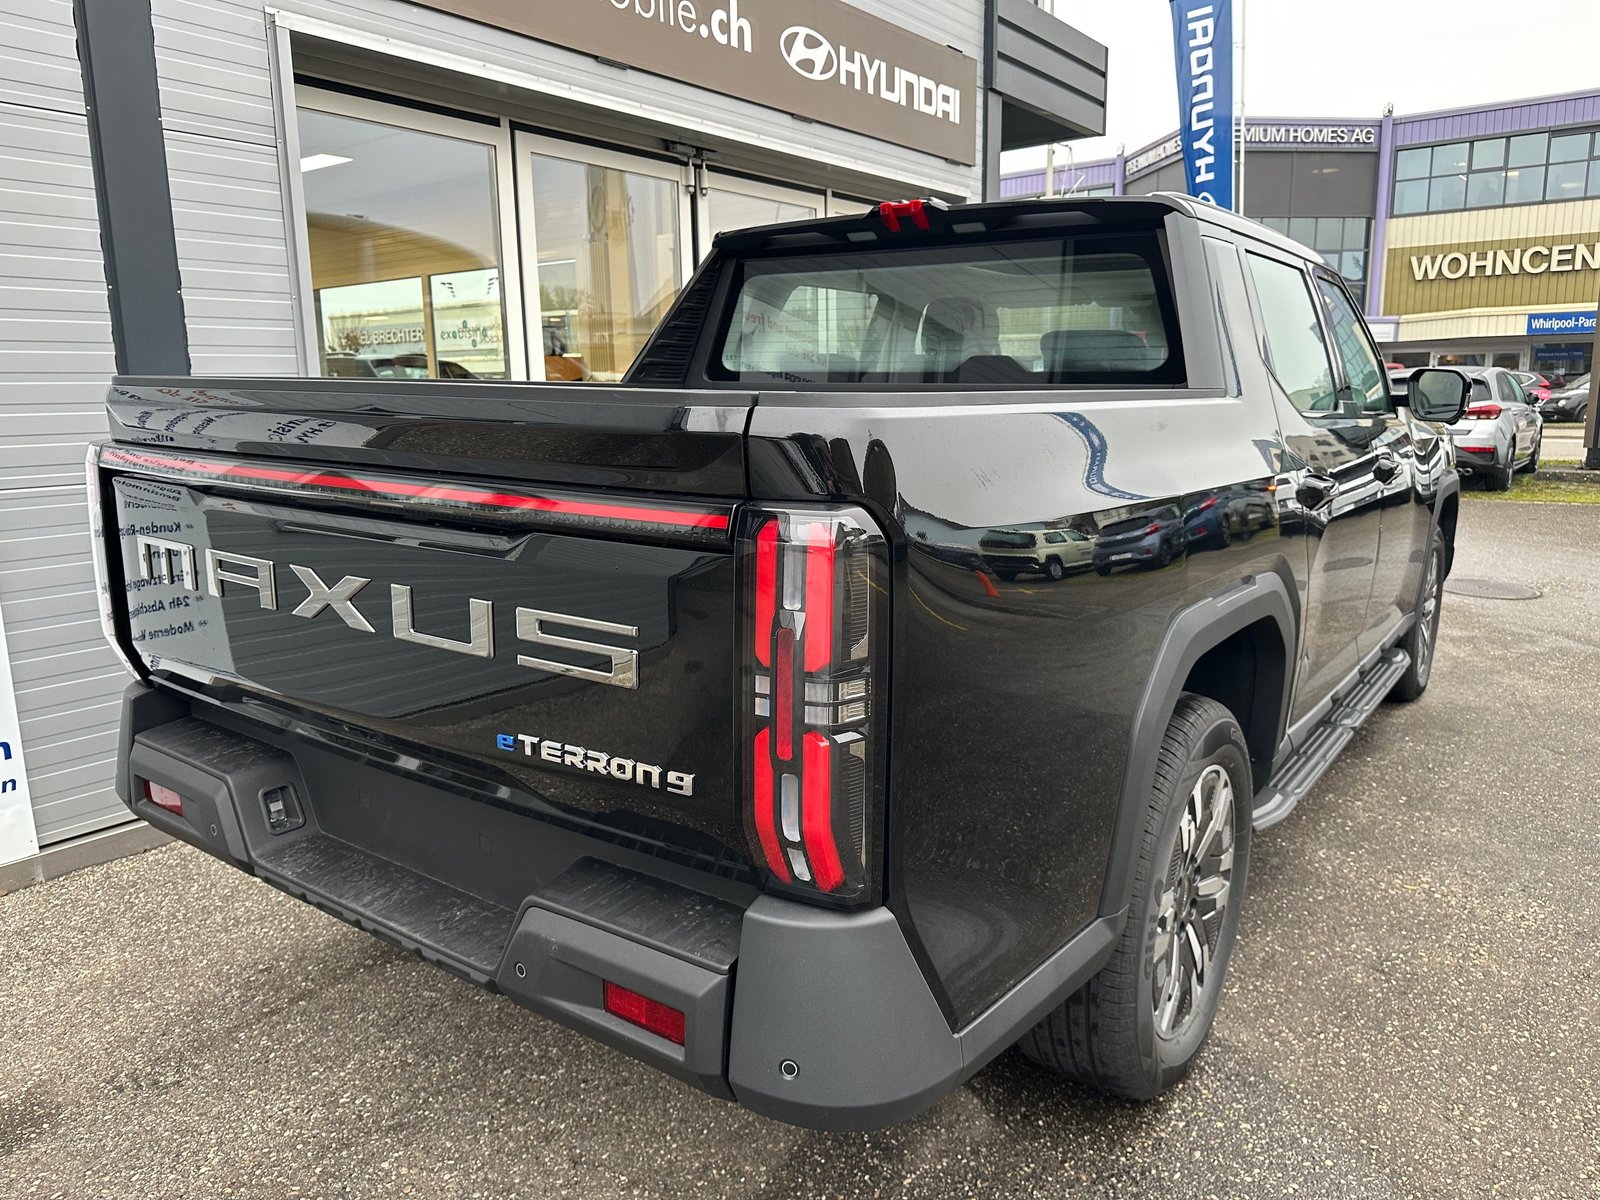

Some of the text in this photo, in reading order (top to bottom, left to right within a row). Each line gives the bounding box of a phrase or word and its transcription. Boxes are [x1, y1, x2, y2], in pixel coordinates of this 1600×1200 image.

[839, 45, 960, 124] HYUNDAI
[1289, 127, 1348, 143] HOMES
[1351, 127, 1375, 143] AG
[1410, 242, 1600, 281] WOHNCEN
[136, 534, 640, 690] MAXUS
[496, 733, 696, 797] eTERRON 9
